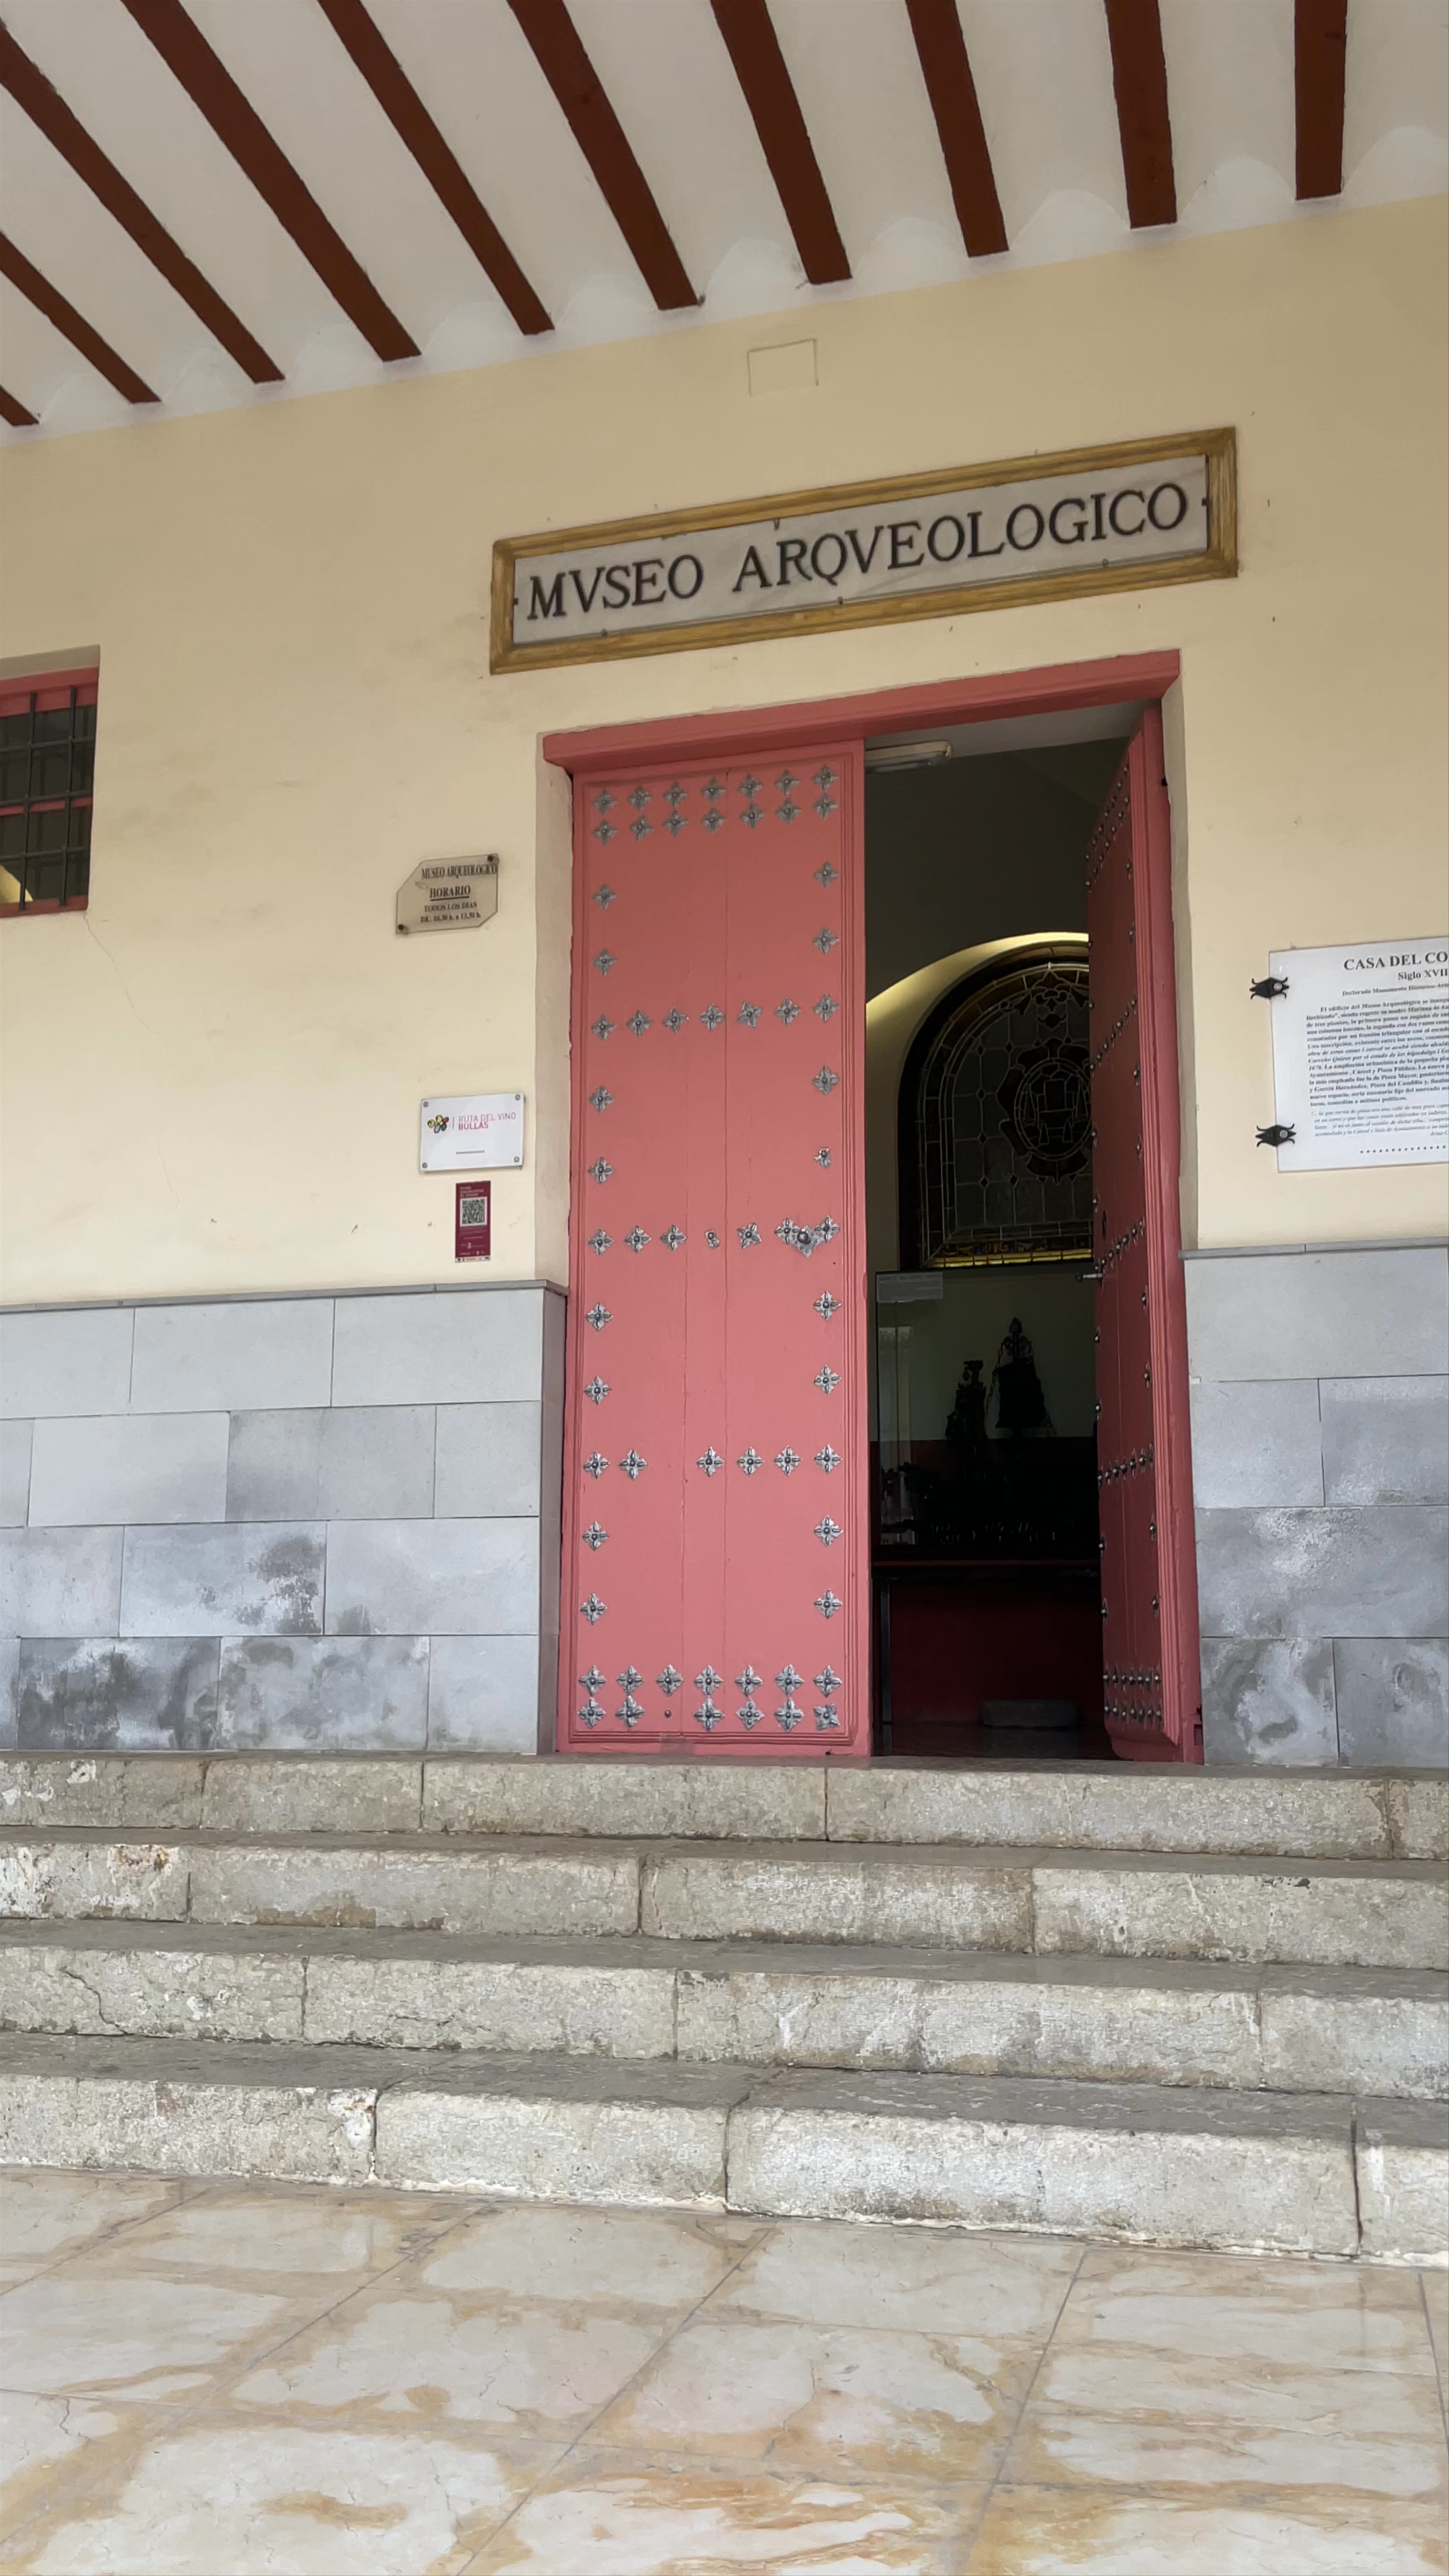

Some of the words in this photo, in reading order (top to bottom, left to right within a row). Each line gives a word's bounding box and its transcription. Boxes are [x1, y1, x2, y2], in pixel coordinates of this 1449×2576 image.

[527, 554, 704, 620] MVSEO
[732, 482, 1188, 592] ARQVEOLOGICO
[421, 867, 445, 879] MUSEO
[430, 885, 471, 898] HORARIO
[1344, 957, 1385, 970] CASA
[1390, 954, 1421, 967] DEL
[1398, 971, 1421, 981] Siglo
[459, 1115, 478, 1123] RUTA
[481, 1113, 496, 1122] DEL
[498, 1112, 516, 1121] VINO
[458, 1121, 489, 1130] BULLAS
